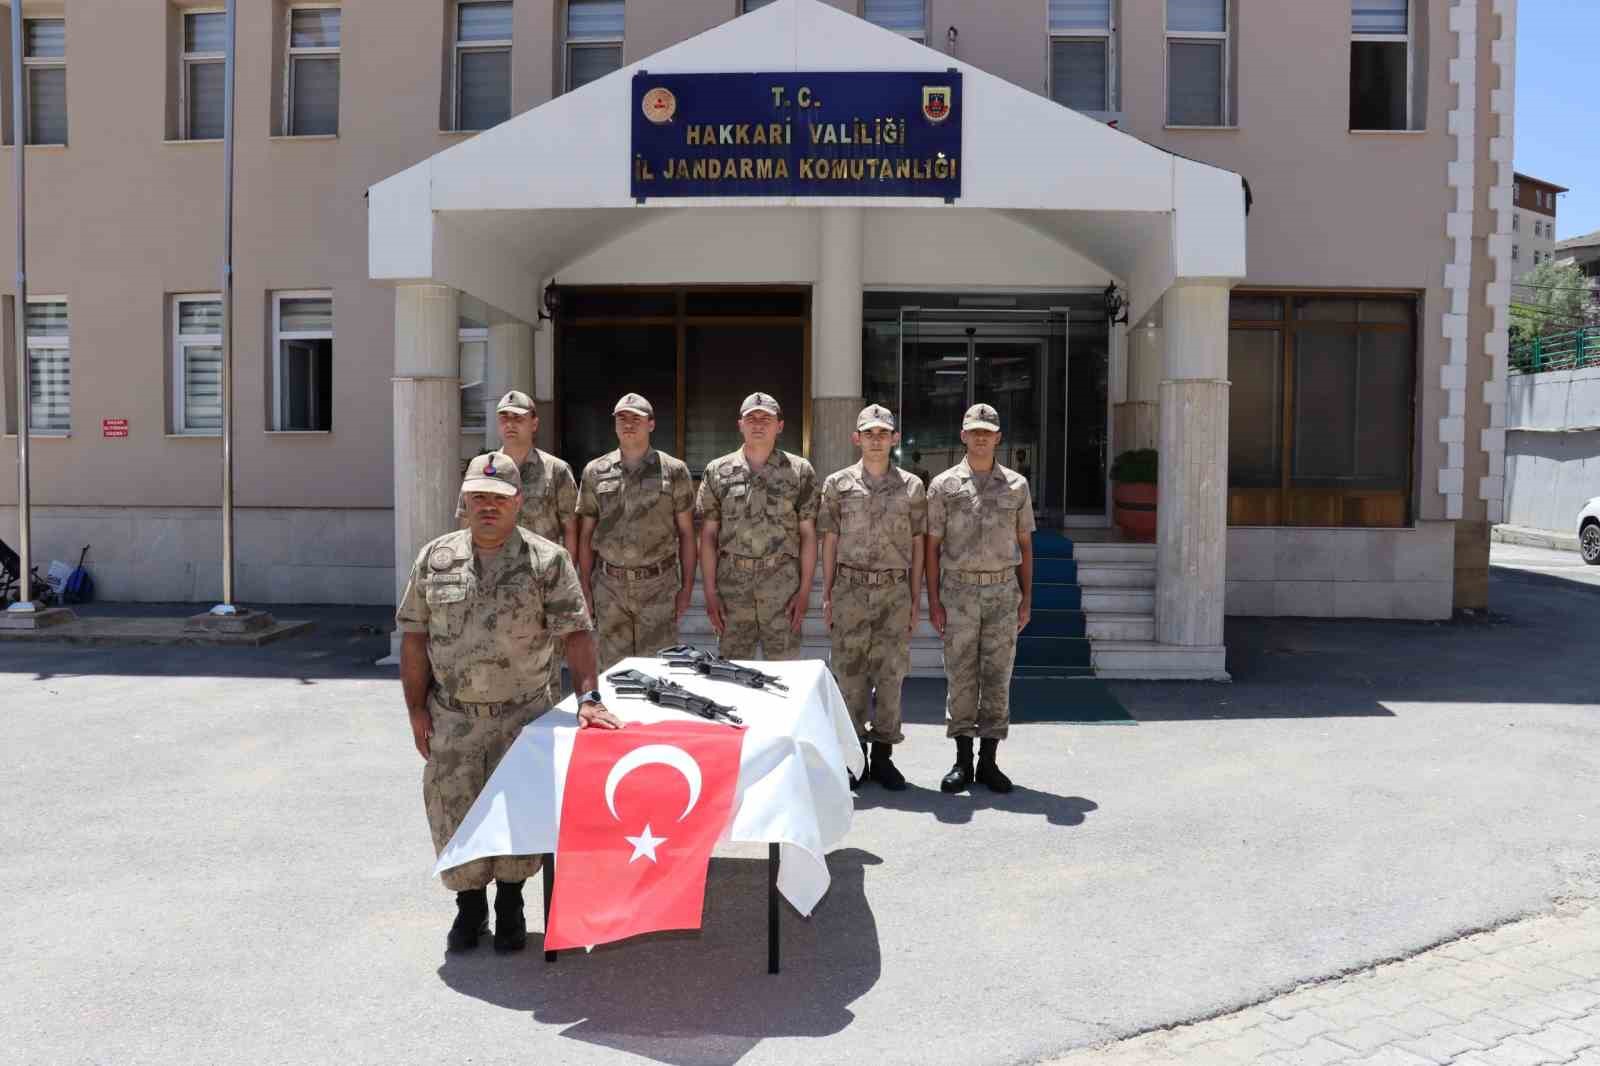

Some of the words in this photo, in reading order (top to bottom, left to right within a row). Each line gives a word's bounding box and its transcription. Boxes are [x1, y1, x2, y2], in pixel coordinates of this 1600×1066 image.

[686, 117, 792, 145] HAKKARİ
[809, 117, 905, 145] VALİLİĞİ
[635, 154, 655, 180] İL
[663, 158, 789, 180] JANDARMA
[799, 152, 959, 180] KOMUTANLIĞI
